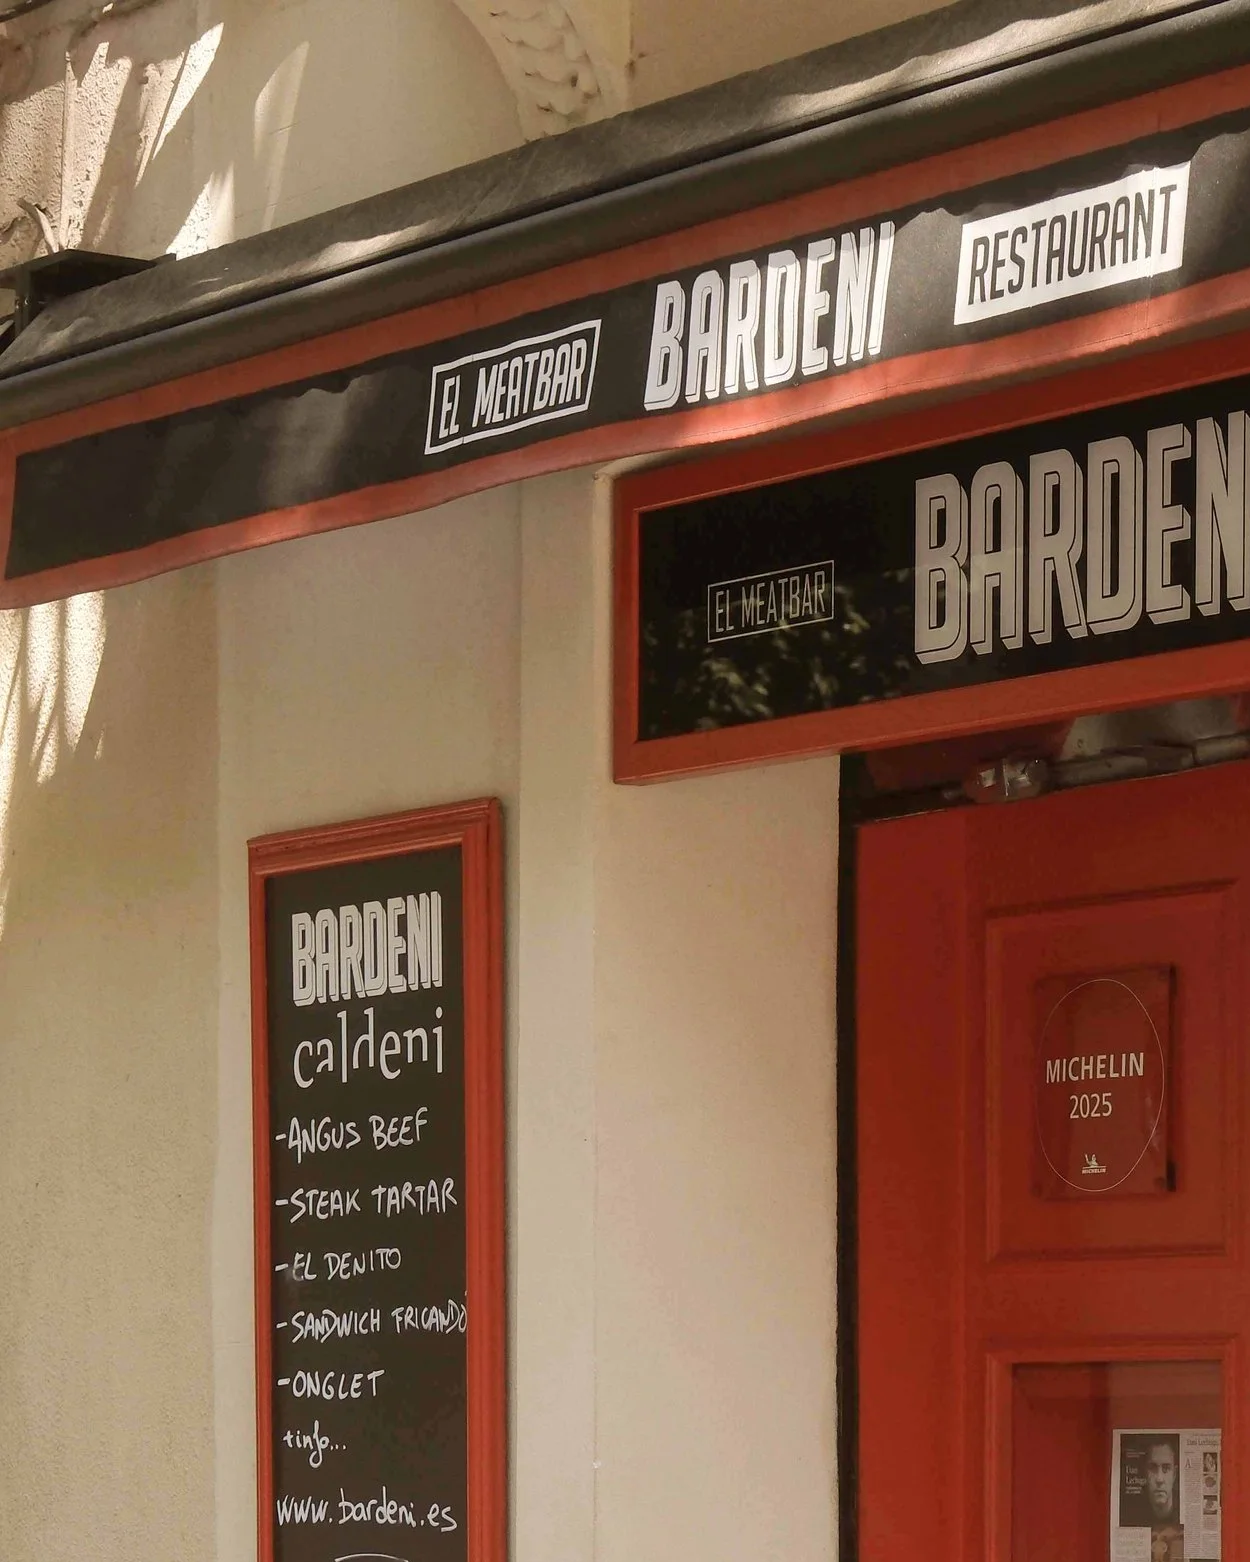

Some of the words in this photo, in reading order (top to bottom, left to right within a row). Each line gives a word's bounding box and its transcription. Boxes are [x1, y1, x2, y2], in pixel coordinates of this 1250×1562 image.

[968, 184, 1177, 305] RESTAURANT
[643, 220, 896, 411] BARDENI
[438, 374, 462, 439] EL
[472, 338, 587, 428] MEATBAR
[715, 589, 734, 633] EL
[741, 570, 826, 628] MEATBAR
[291, 891, 443, 1007] BARDENI
[293, 1007, 444, 1089] caldeni
[1046, 1052, 1144, 1084] MICHELIN
[368, 1107, 428, 1150] BEEF
[1069, 1092, 1112, 1119] 2025
[371, 1178, 458, 1218] TARTAR
[324, 1247, 401, 1280] DENITO
[276, 1486, 458, 1532] www.bardeni.es
